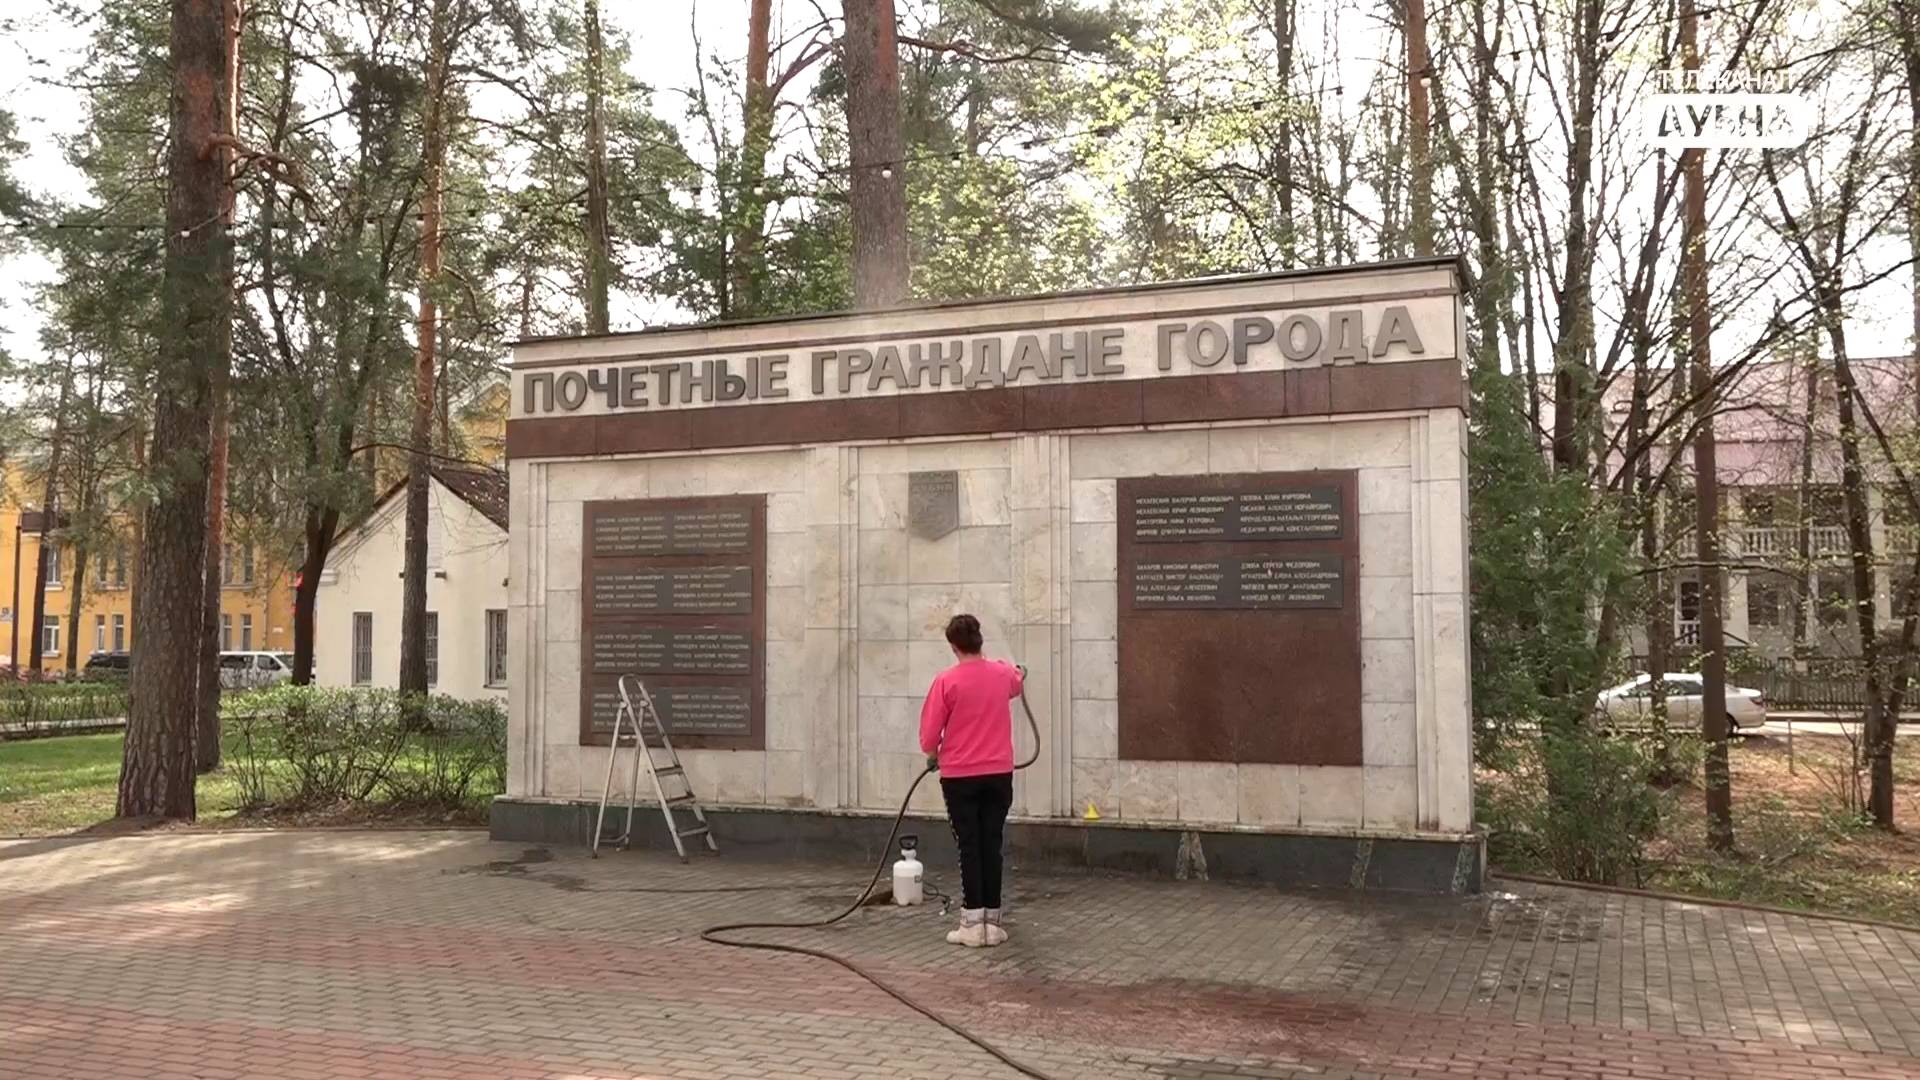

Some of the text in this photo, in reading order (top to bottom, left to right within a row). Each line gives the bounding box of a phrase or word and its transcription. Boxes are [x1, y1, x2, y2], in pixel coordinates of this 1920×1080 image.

[523, 305, 1425, 414] ПОЧЕТНЫЕ ГРАЖДАНЕ ГОРОДА
